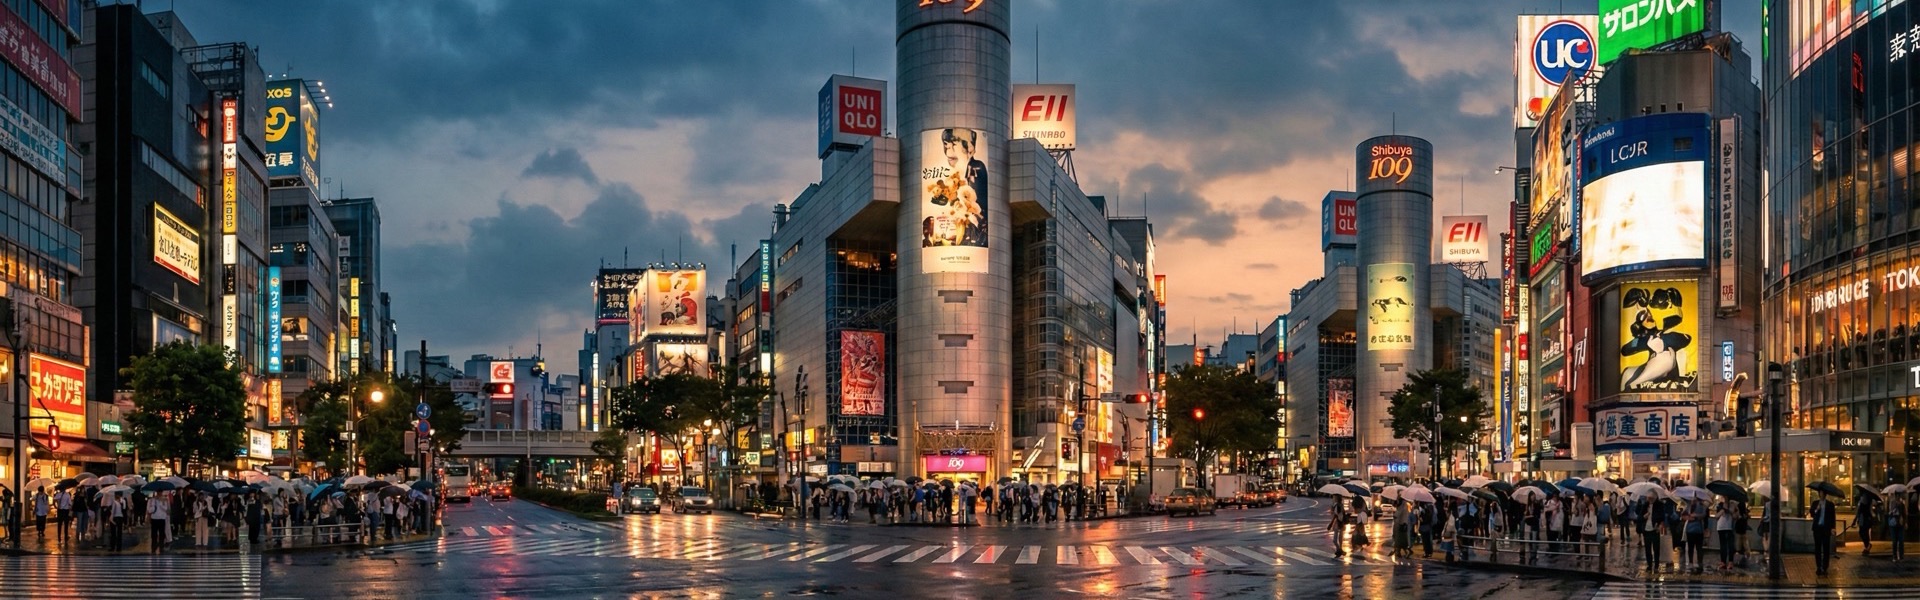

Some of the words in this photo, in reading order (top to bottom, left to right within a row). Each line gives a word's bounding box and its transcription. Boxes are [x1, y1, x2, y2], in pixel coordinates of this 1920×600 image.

[844, 93, 875, 111] UNI
[844, 111, 877, 129] QLO
[1371, 144, 1413, 158] Shibuya
[1368, 156, 1413, 184] 109
